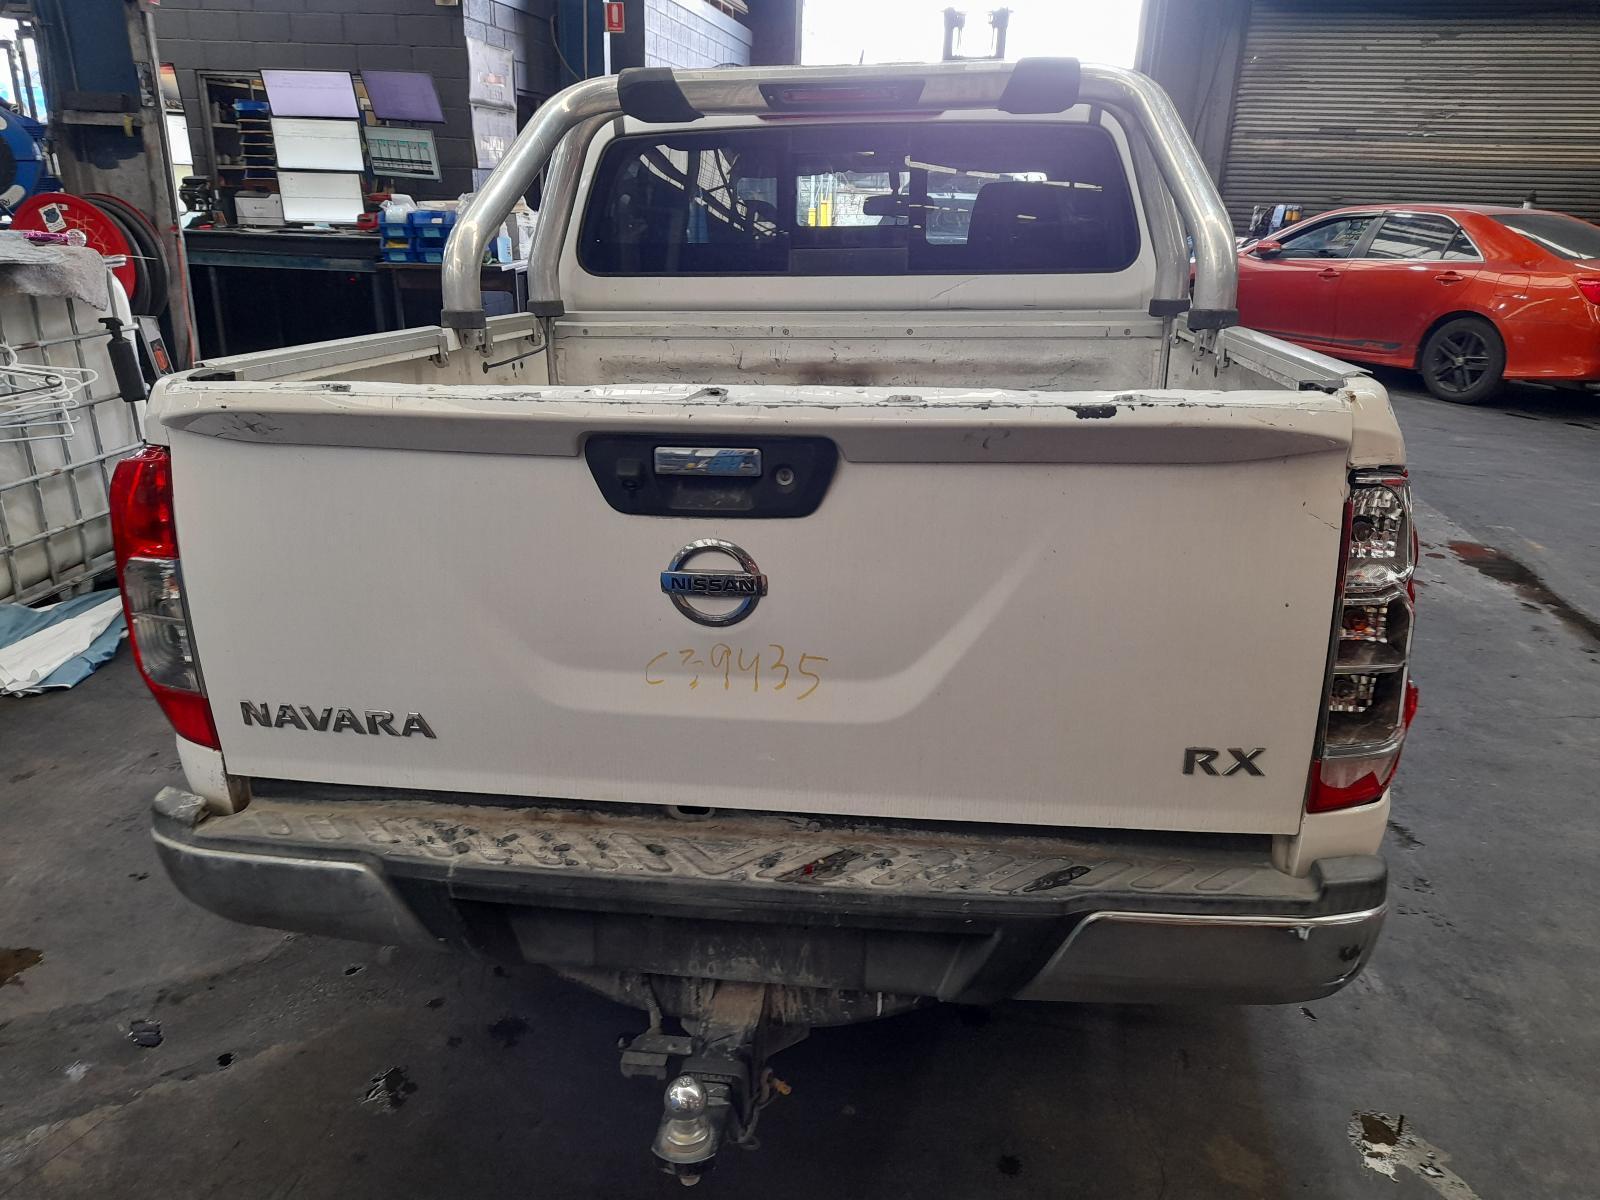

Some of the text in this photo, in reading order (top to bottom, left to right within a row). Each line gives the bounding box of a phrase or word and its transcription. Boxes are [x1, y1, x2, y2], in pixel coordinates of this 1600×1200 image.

[671, 577, 757, 593] NISSAN
[645, 643, 829, 700] C39435
[240, 699, 437, 739] NAVARA
[1182, 746, 1266, 776] RX
